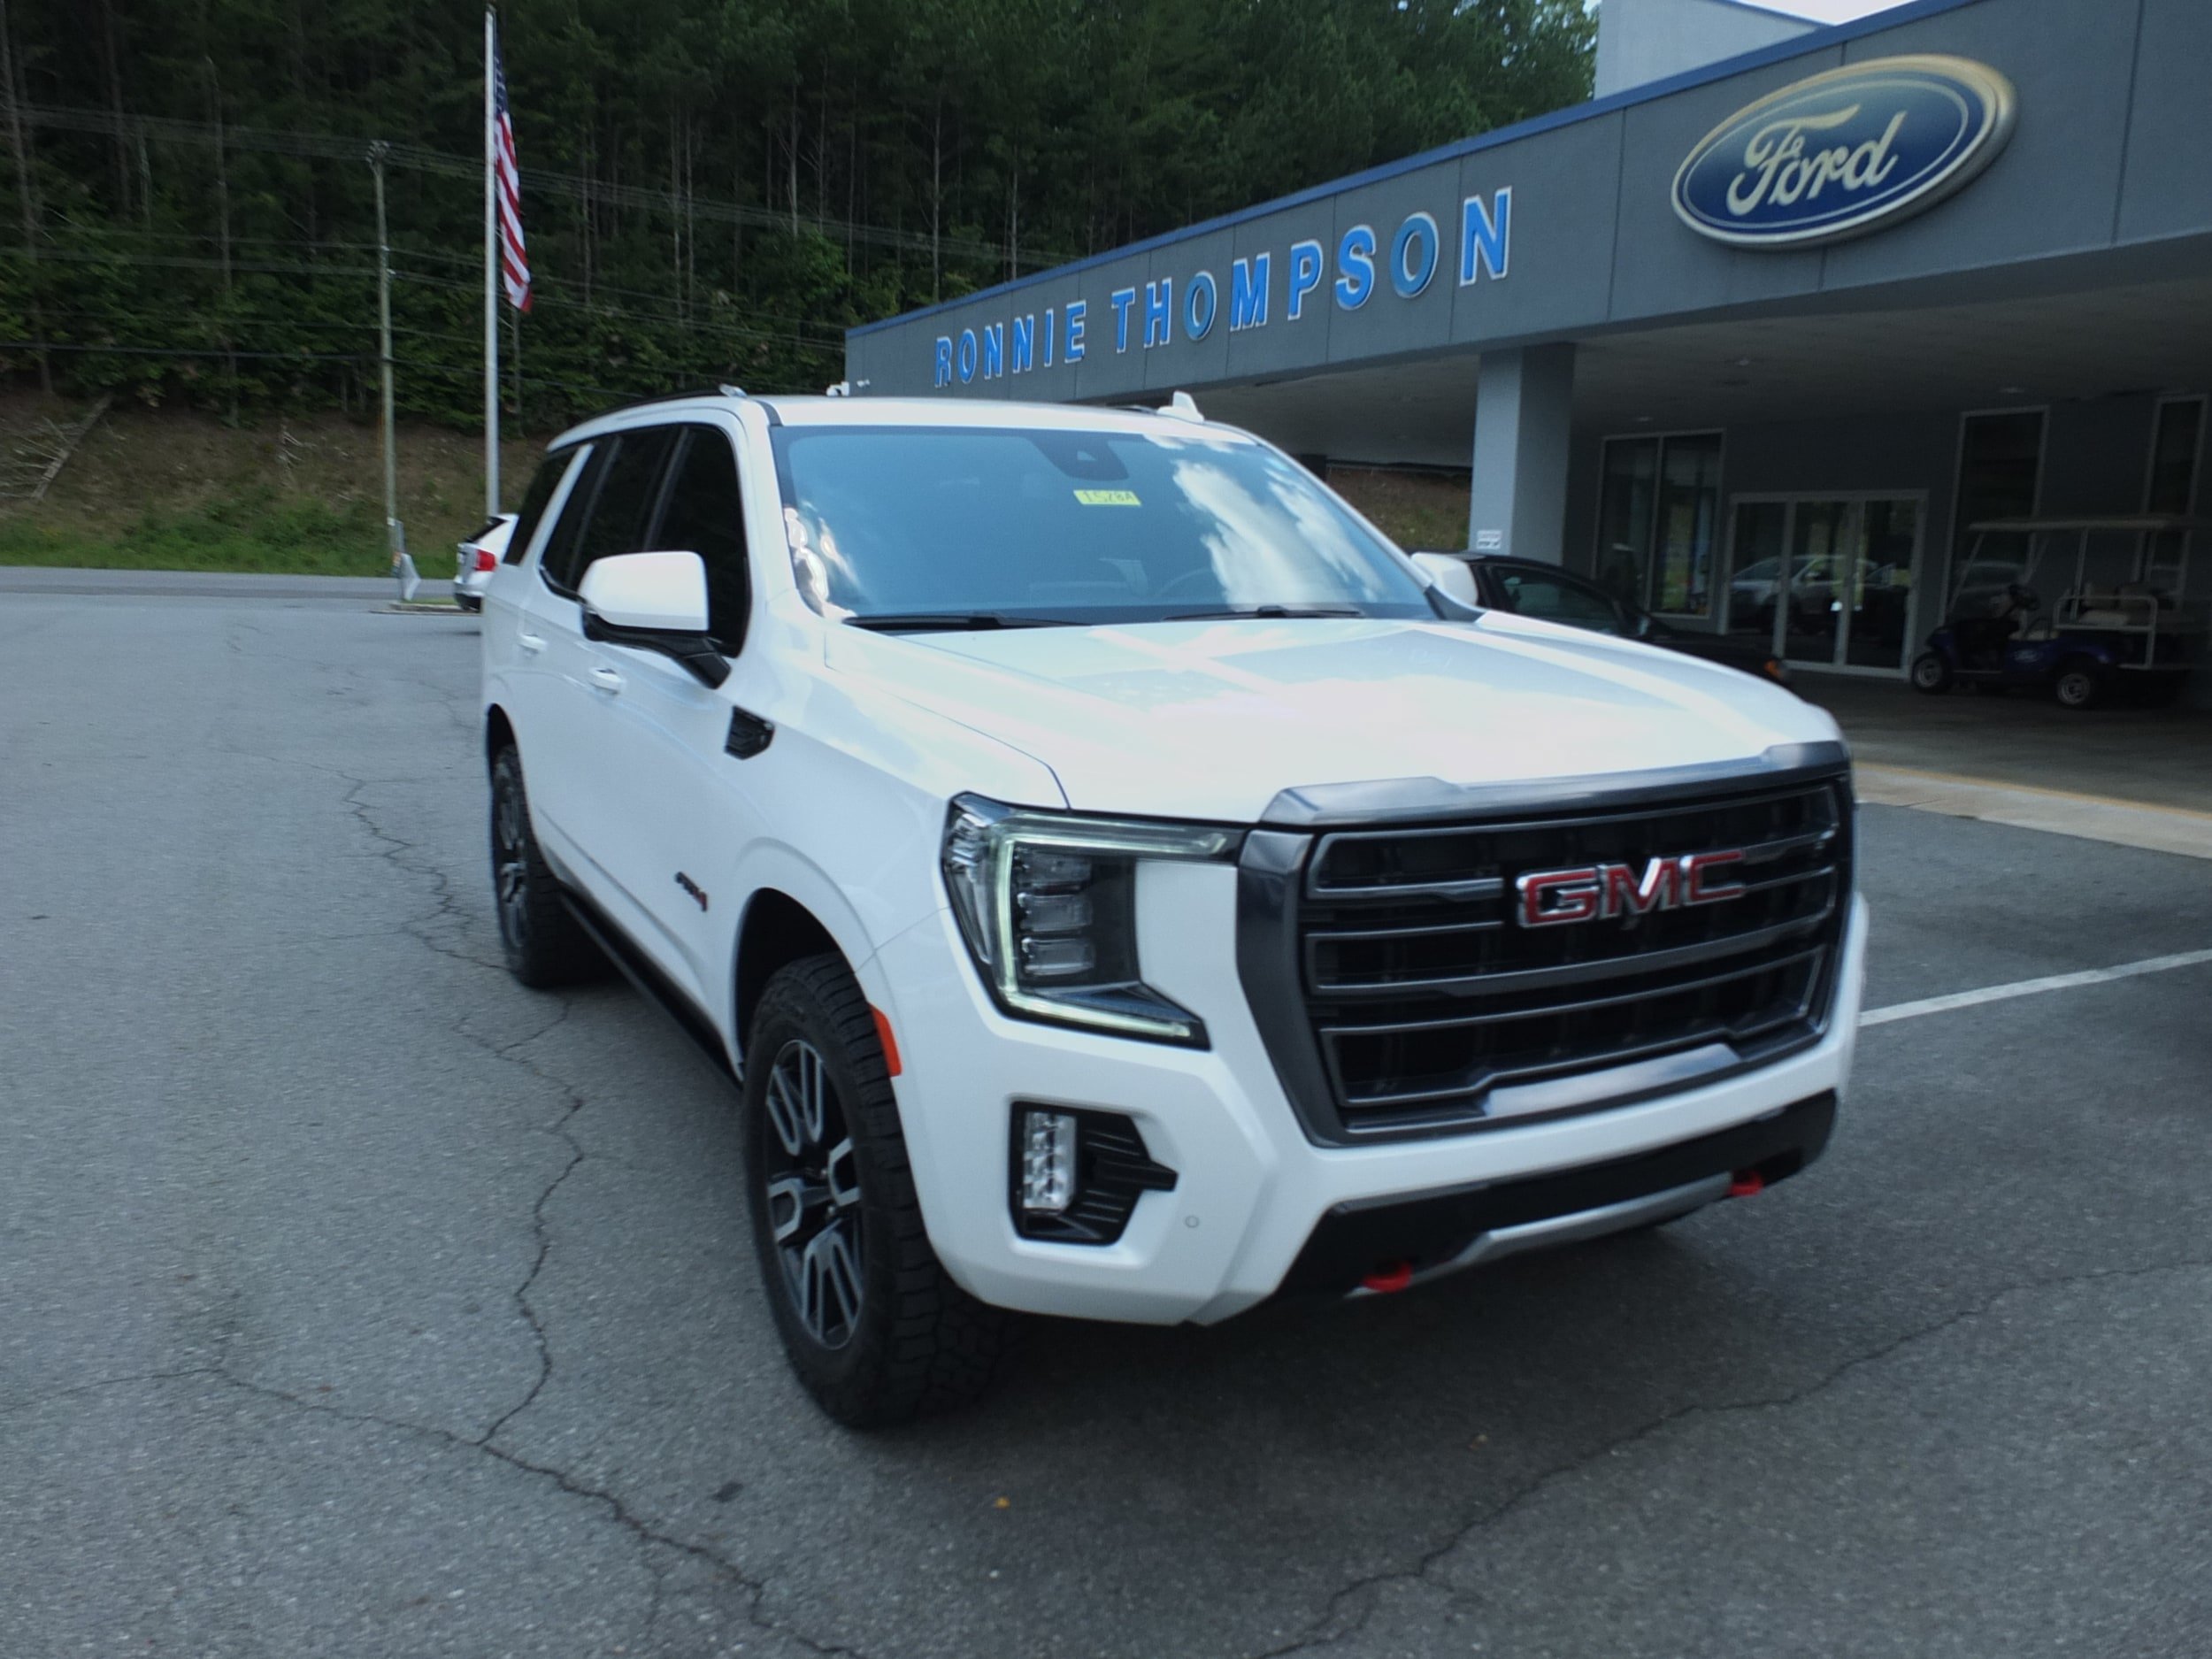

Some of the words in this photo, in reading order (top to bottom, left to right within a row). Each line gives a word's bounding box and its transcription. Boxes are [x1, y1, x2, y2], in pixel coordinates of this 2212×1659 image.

[1726, 104, 1908, 216] Ford
[934, 300, 1087, 388] RONNIE
[1110, 186, 1512, 354] THOMPSON
[1517, 849, 1746, 927] GMC
